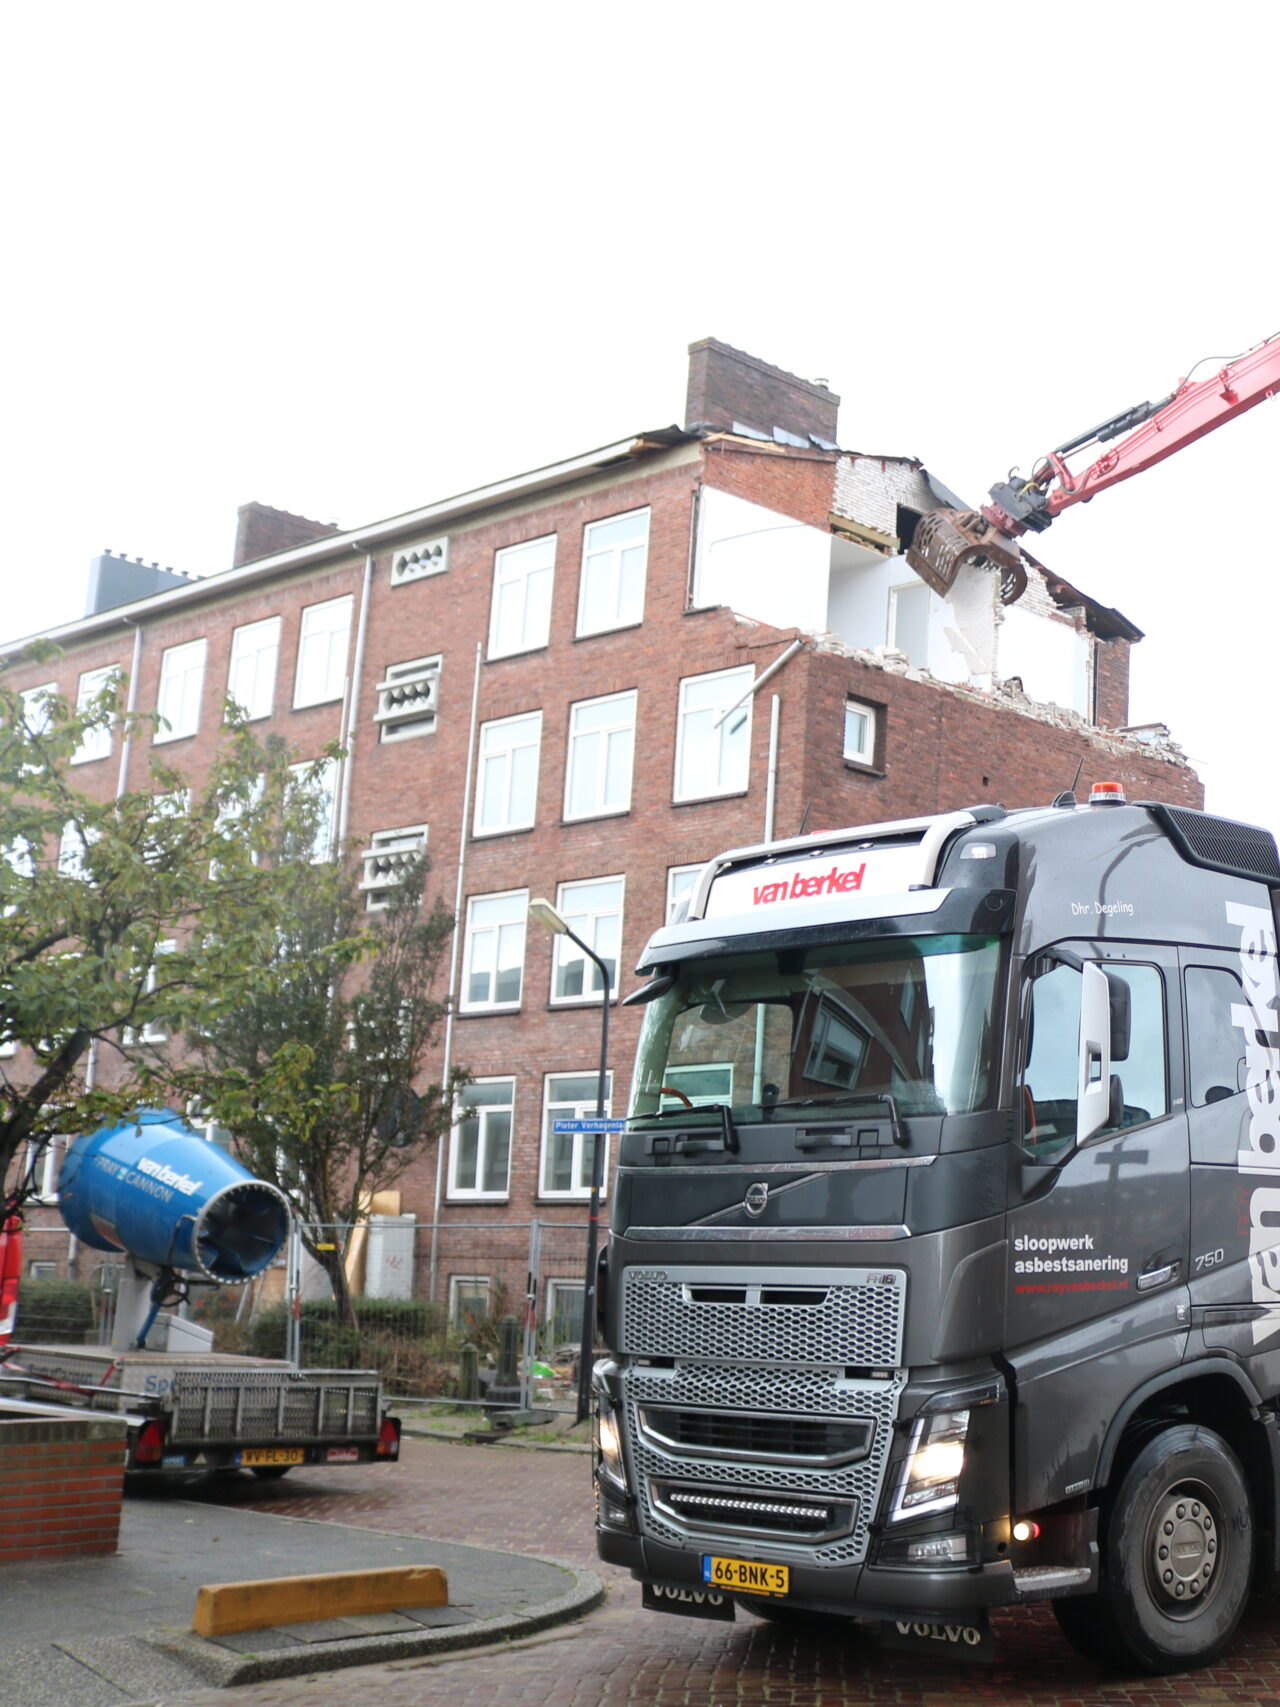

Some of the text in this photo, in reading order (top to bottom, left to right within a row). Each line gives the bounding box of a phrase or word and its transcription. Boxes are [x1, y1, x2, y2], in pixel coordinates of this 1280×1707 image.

[753, 862, 867, 905] van berkel
[1070, 901, 1134, 917] Dhr. Degeling
[555, 1121, 579, 1130] Pieter
[124, 1171, 174, 1203] CANNON
[1014, 1234, 1094, 1254] sloopwerk
[1014, 1255, 1128, 1274] asbestsanering
[1195, 1248, 1225, 1272] 750
[715, 1561, 785, 1588] 66-BNK-5
[895, 1621, 981, 1645] VOLVO
